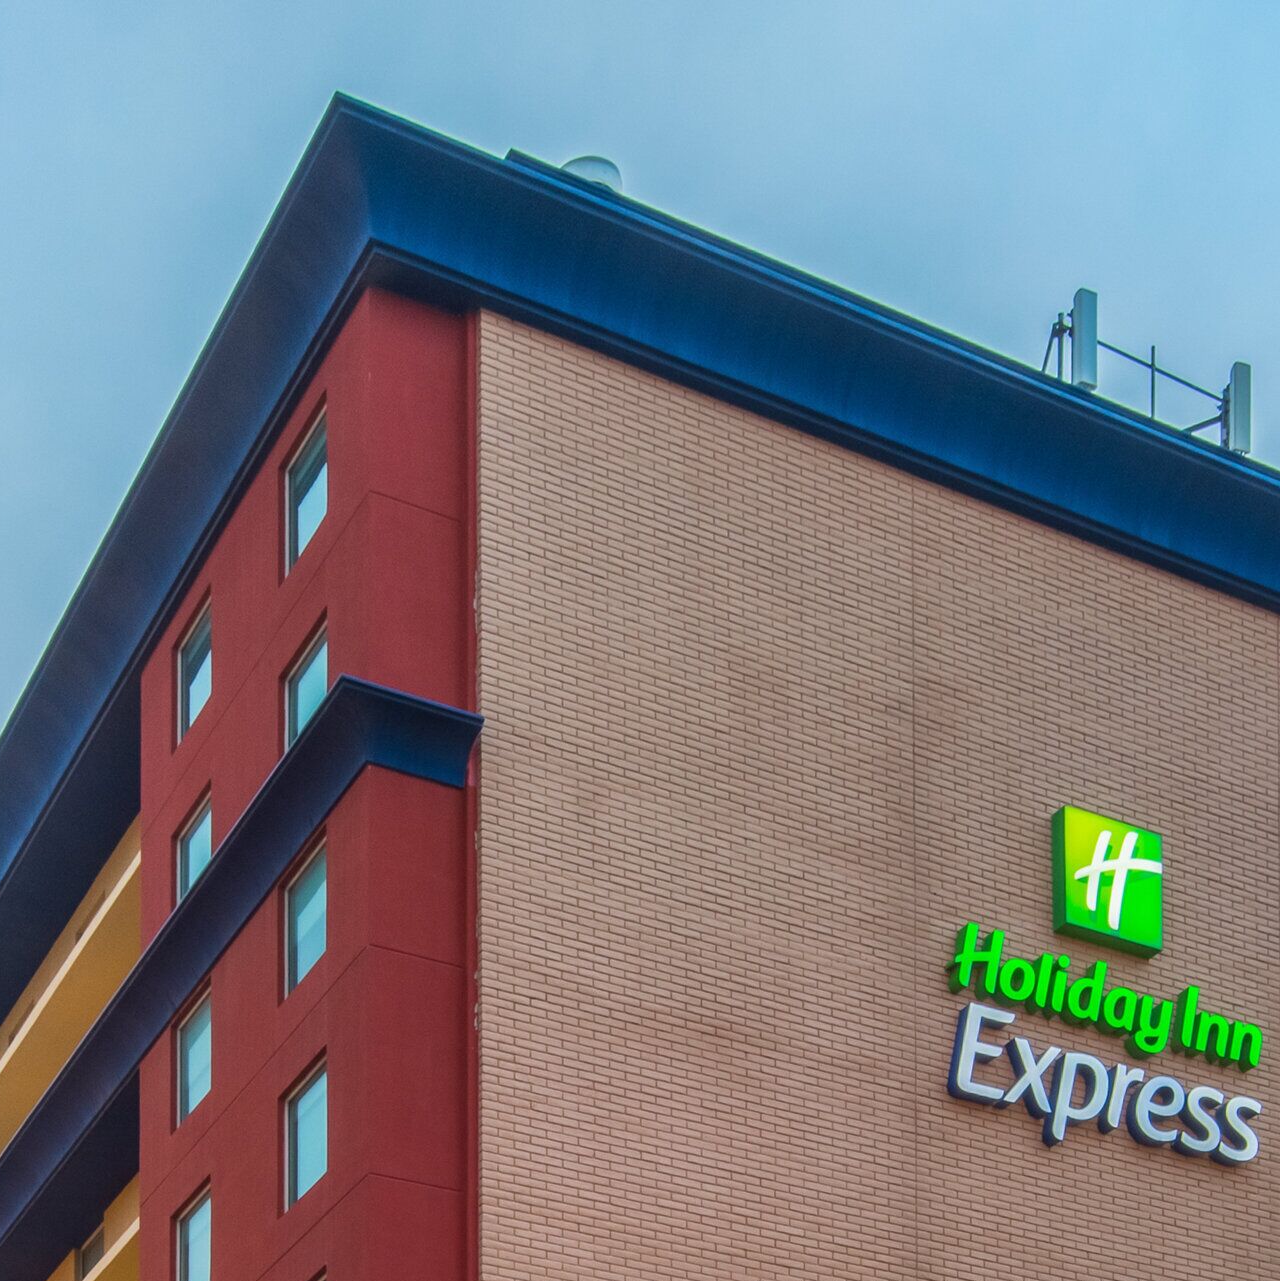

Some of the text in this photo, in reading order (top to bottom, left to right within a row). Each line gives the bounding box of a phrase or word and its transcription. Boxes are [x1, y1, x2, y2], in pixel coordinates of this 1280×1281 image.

[949, 921, 1263, 1072] Holiday Inn
[949, 1001, 1263, 1166] Express
